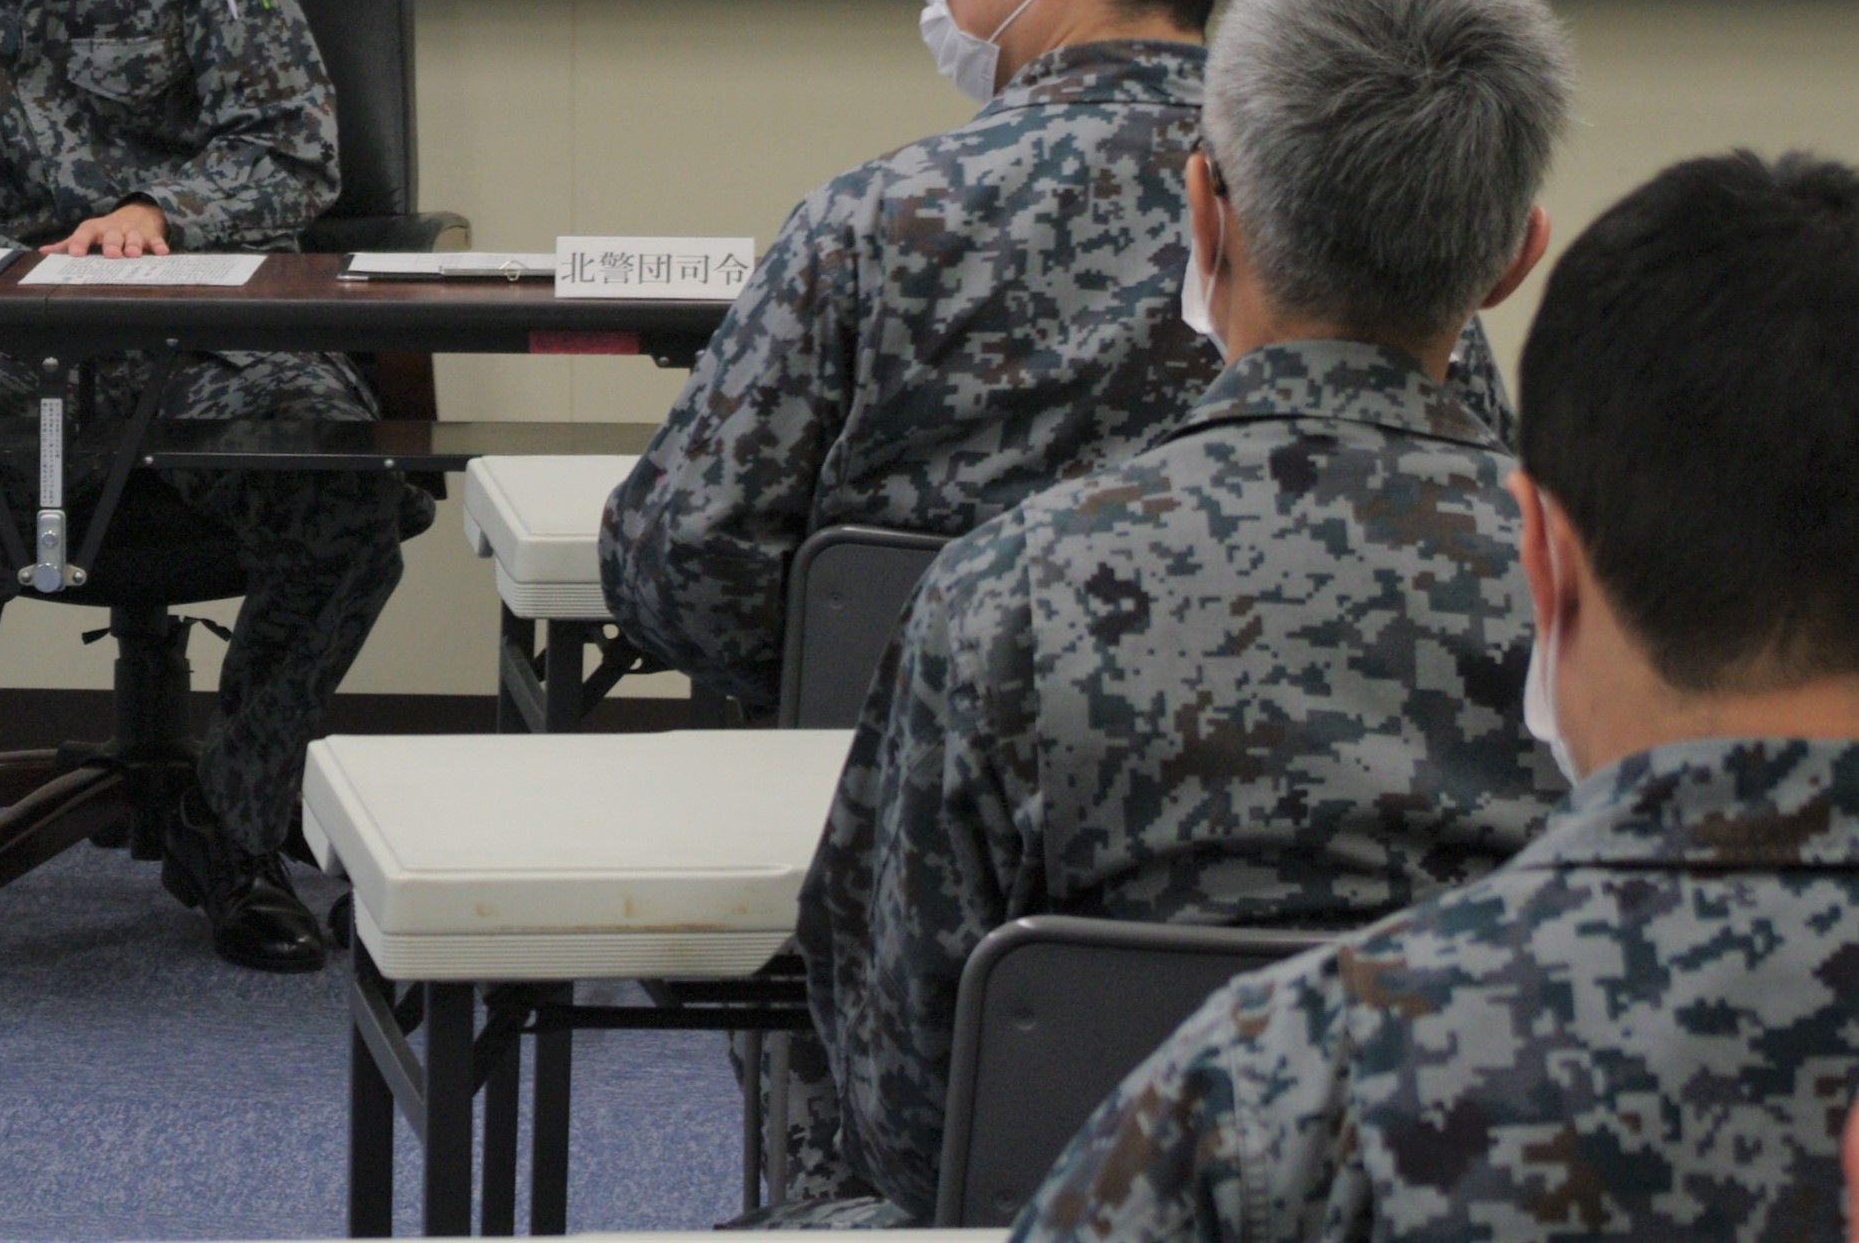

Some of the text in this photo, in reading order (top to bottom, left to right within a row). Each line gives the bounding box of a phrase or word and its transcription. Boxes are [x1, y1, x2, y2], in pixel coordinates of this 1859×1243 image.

[560, 251, 749, 286] 北警団司令
